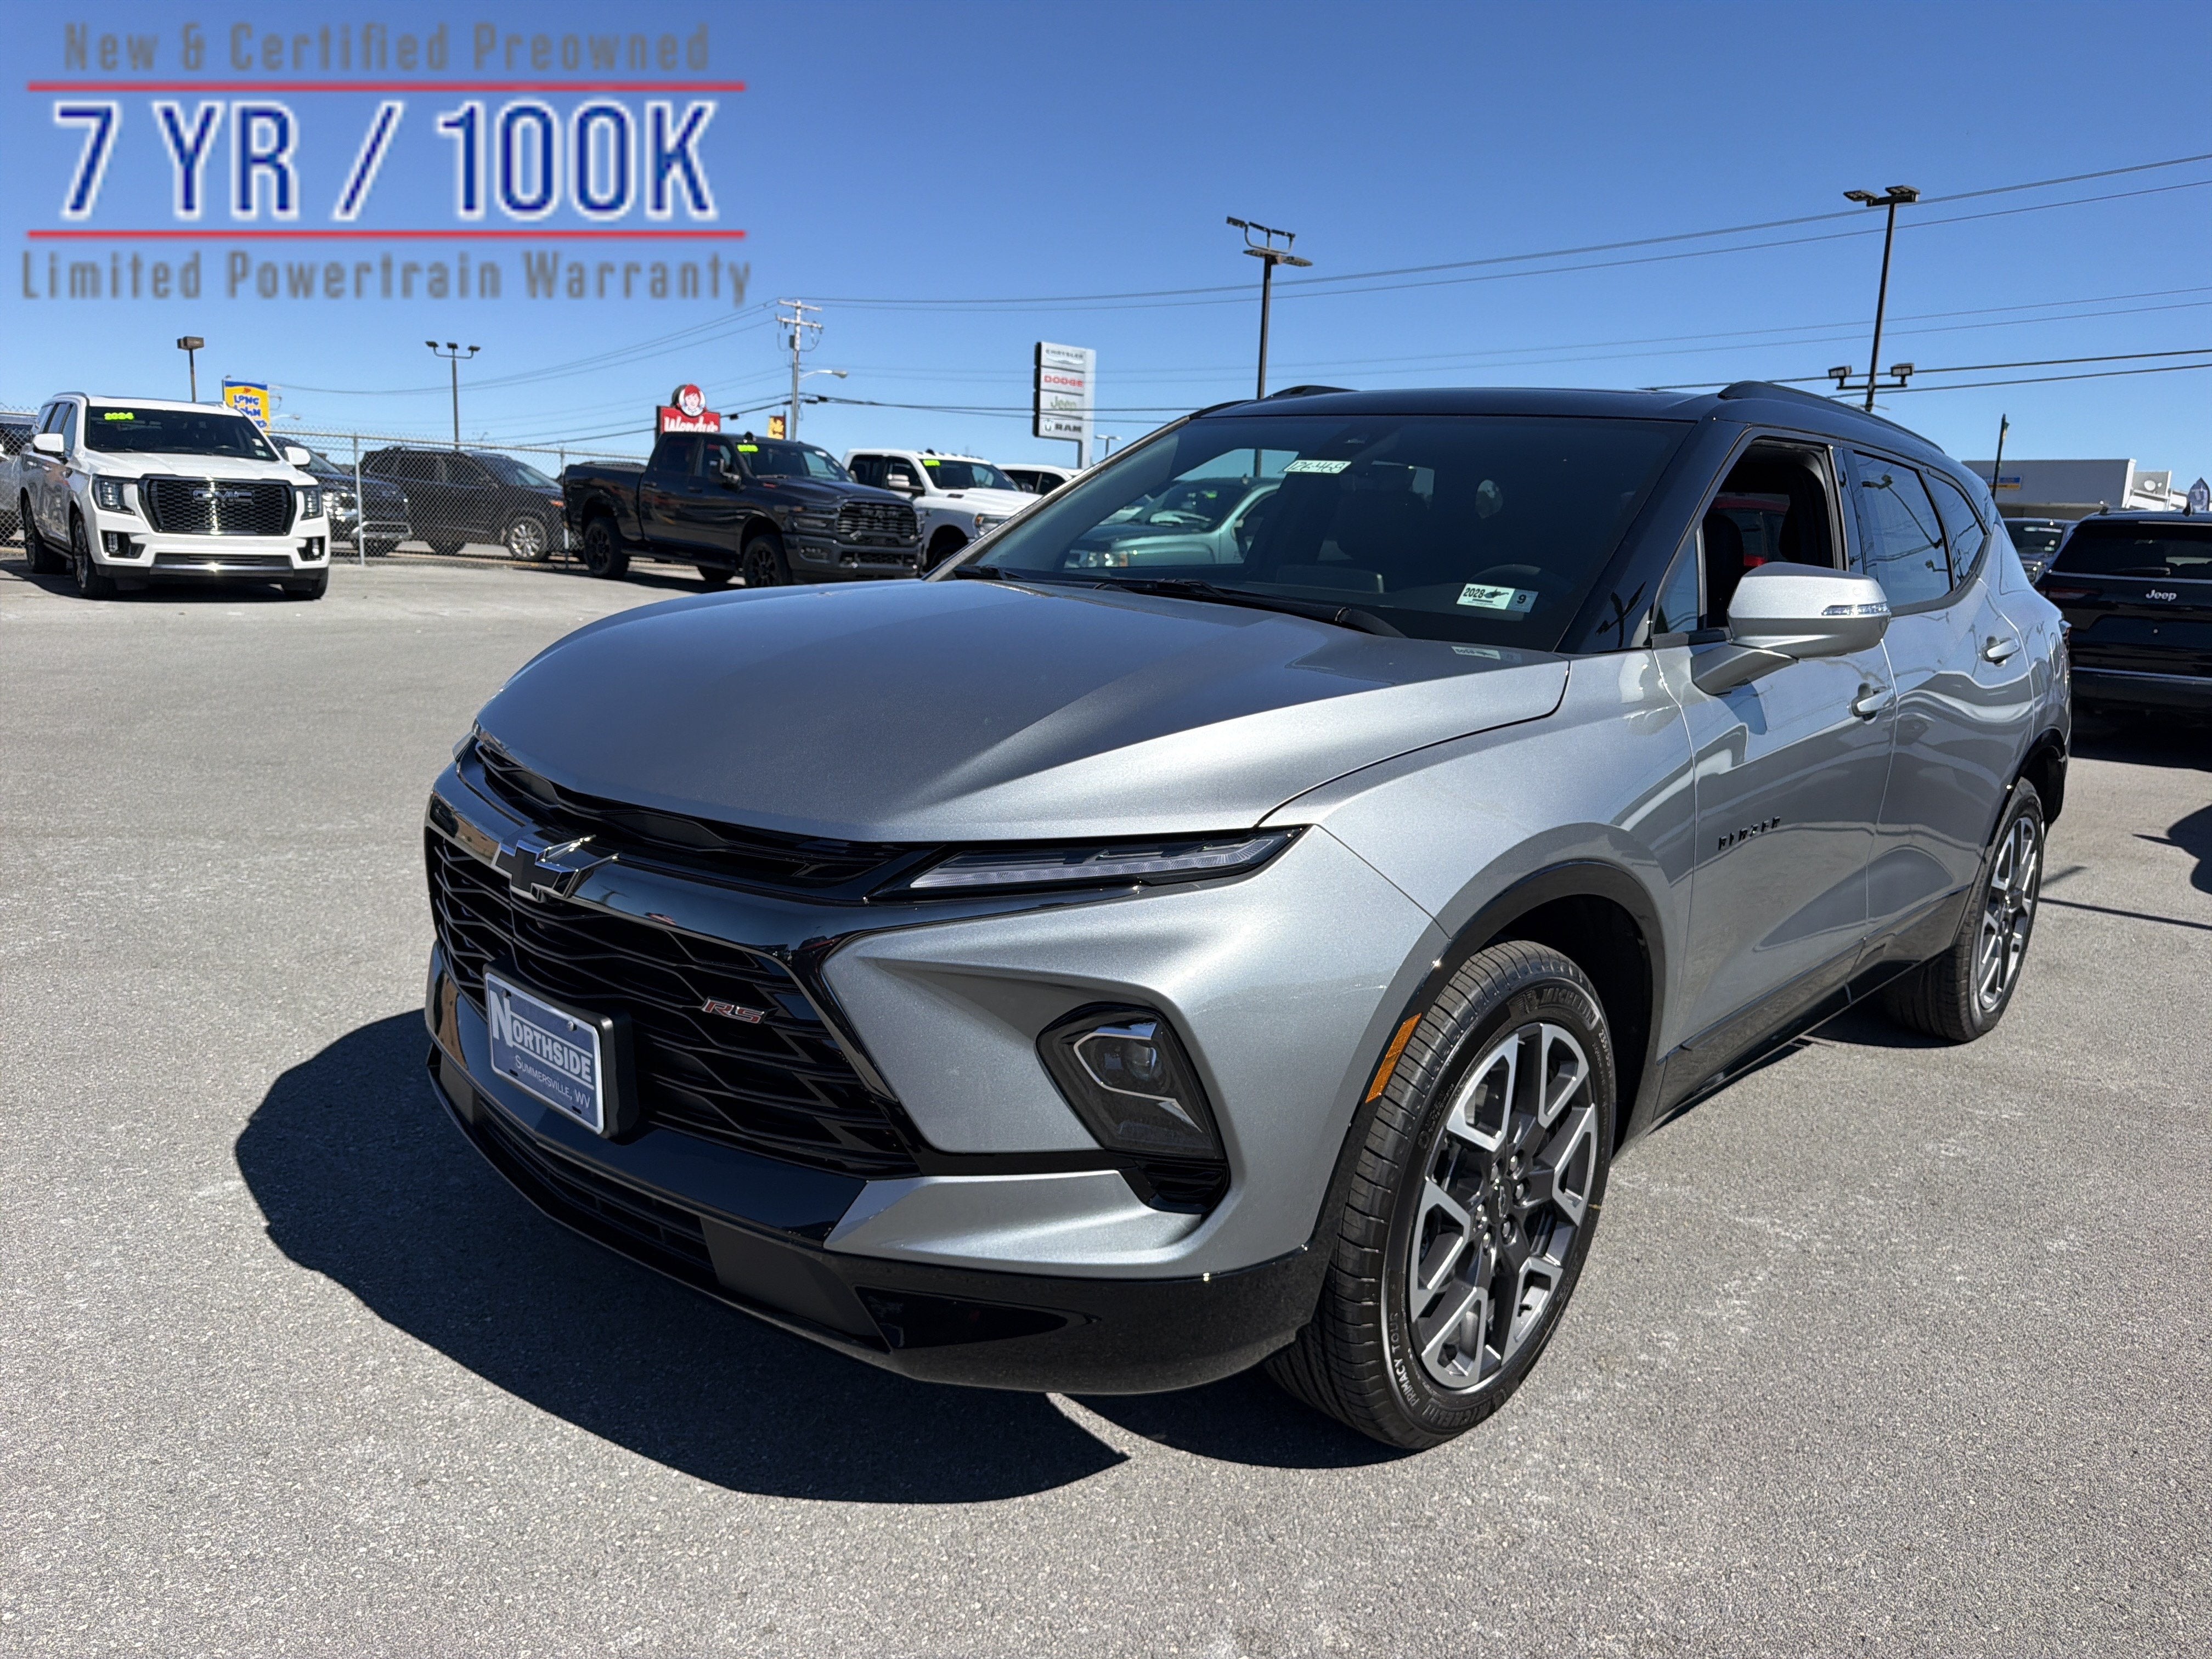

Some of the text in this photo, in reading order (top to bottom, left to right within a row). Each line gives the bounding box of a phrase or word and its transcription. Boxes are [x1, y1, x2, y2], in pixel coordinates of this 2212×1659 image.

[1044, 375, 1084, 387] DODGE
[1051, 396, 1077, 410] Jeep
[1054, 422, 1082, 433] RAM
[1463, 587, 1486, 599] 2028
[1516, 594, 1527, 604] 9
[2145, 589, 2177, 602] Jeep
[702, 998, 765, 1024] RS
[574, 1088, 591, 1109] WV
[1393, 1358, 1420, 1407] PRIMACY
